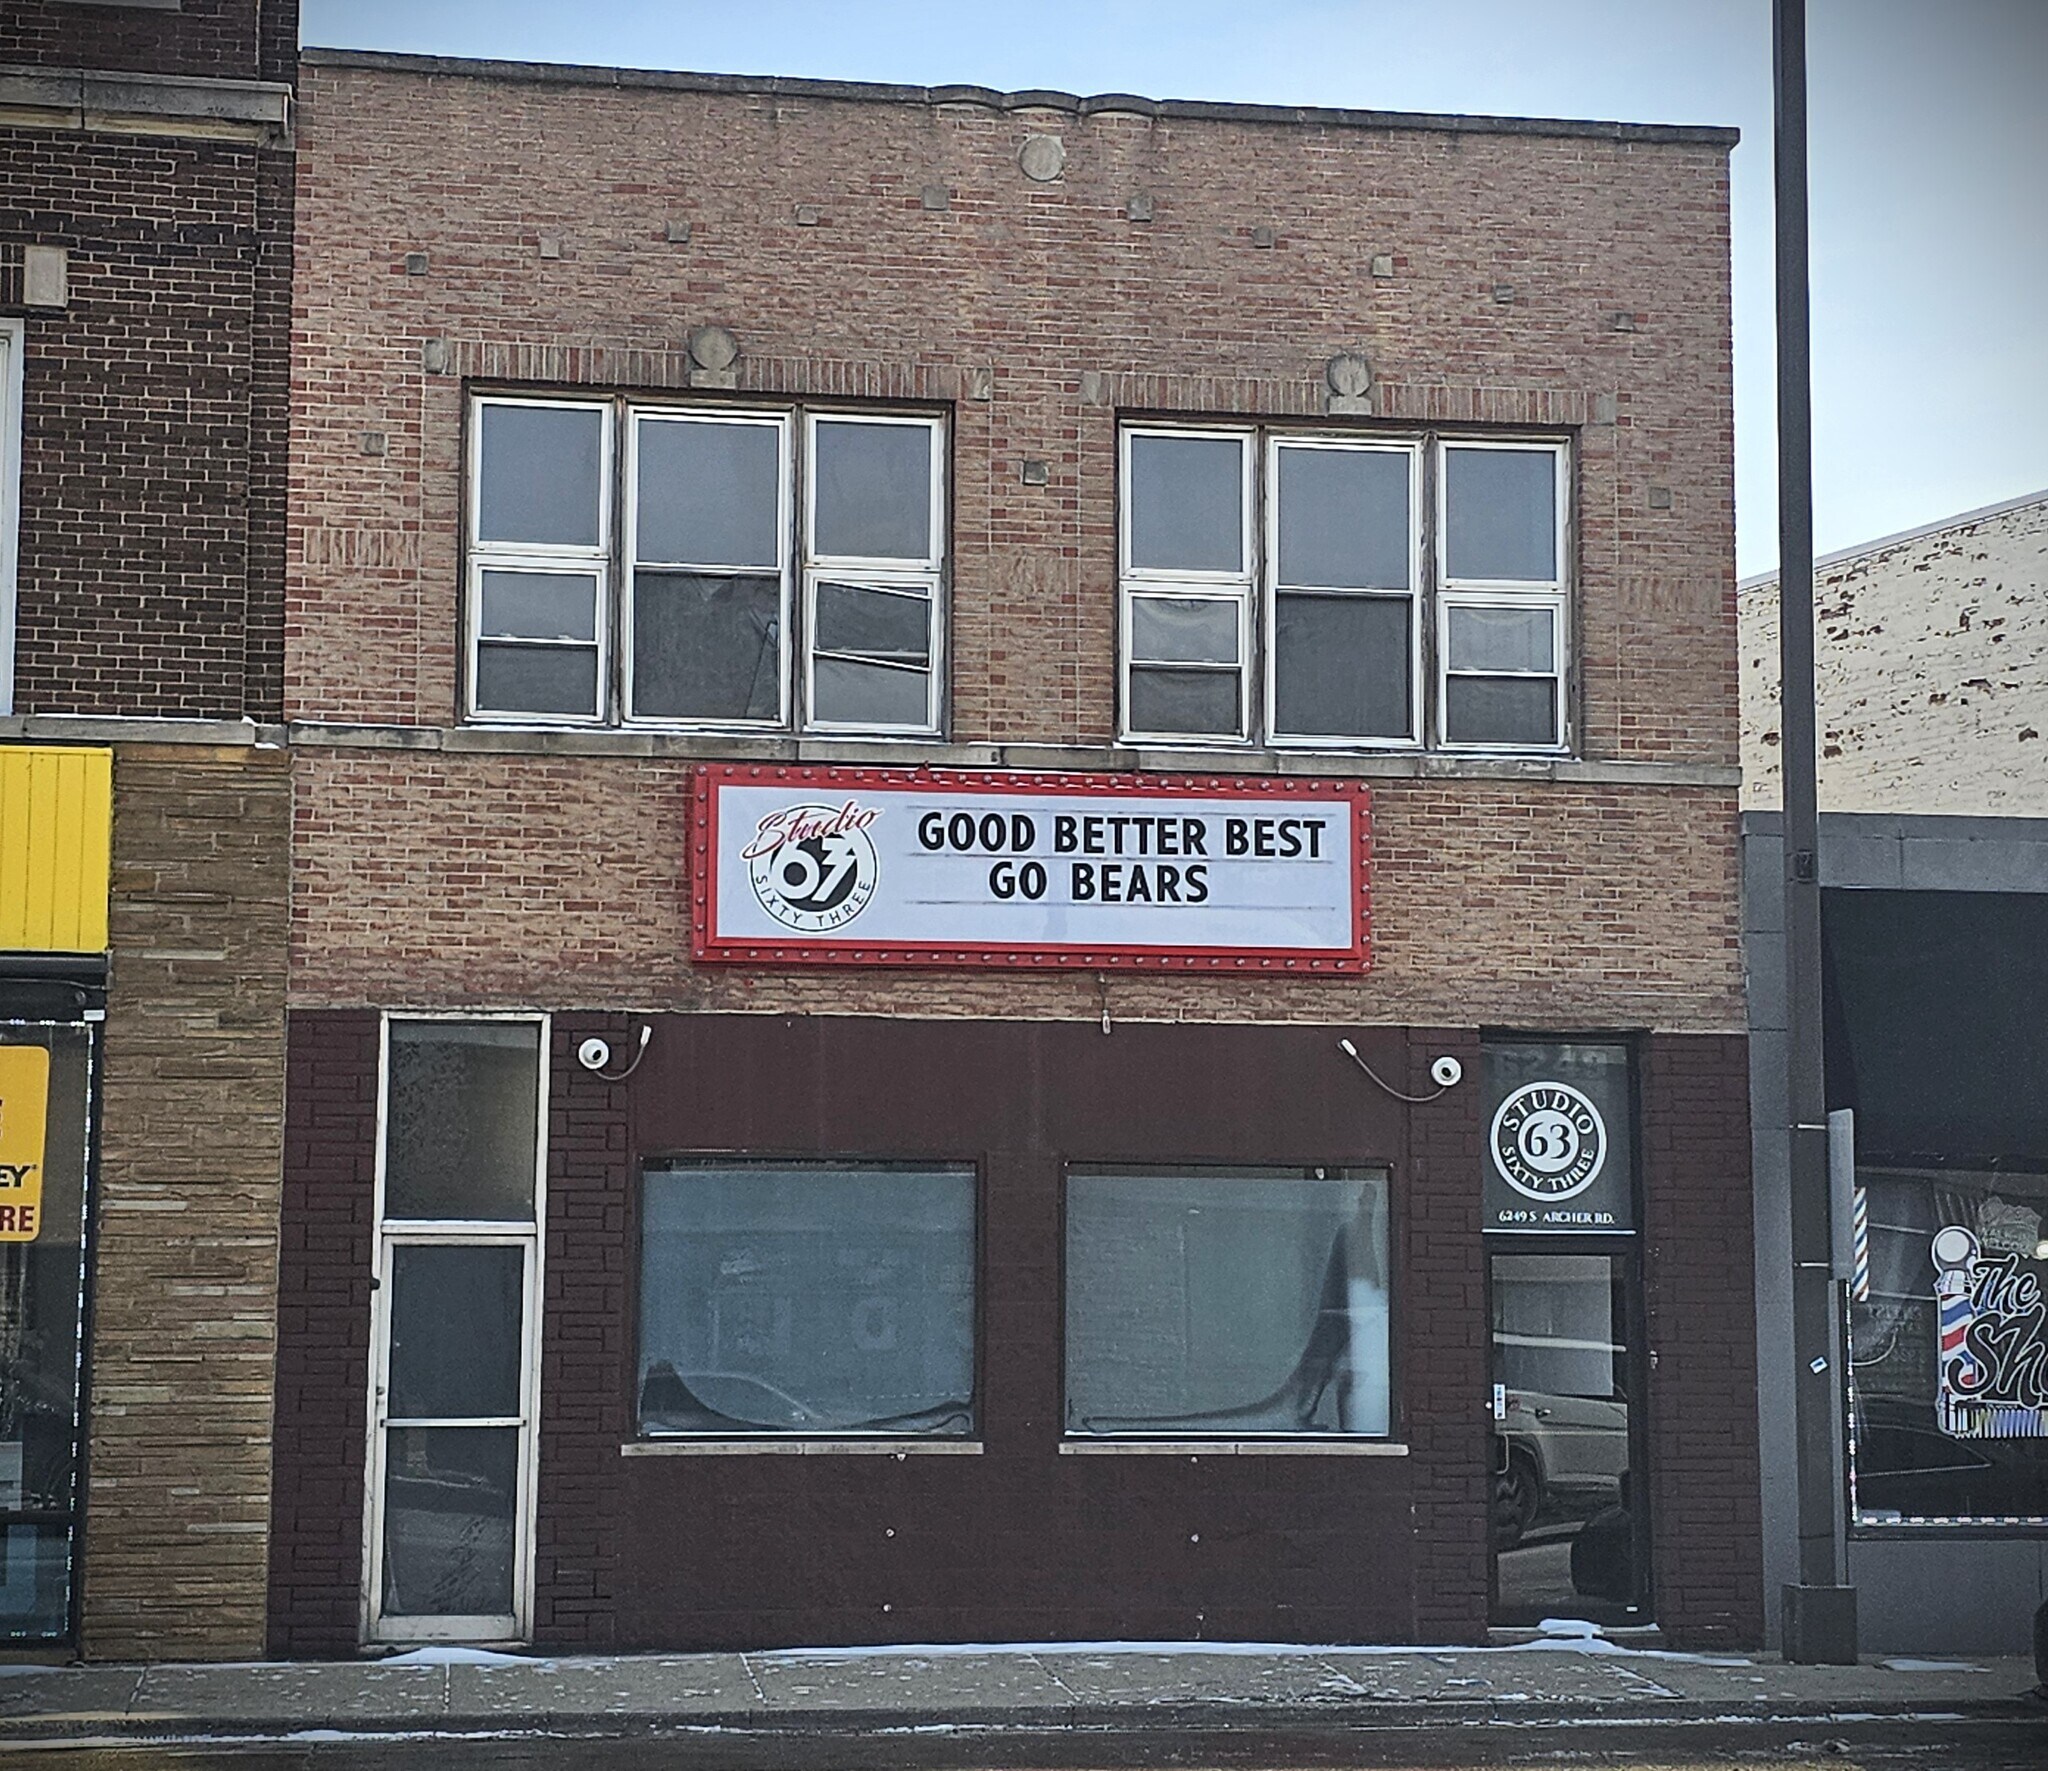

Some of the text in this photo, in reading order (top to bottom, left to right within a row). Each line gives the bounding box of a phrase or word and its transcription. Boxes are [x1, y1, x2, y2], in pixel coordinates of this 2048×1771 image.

[742, 800, 881, 859] Studio
[918, 811, 1327, 858] GOOD BETTER BEST
[756, 874, 871, 927] SIXTY THREE
[989, 861, 1209, 902] GO BEARS
[1502, 1090, 1594, 1135] STUDIO
[1524, 1121, 1571, 1160] 63
[1502, 1146, 1595, 1191] SIXTY THREE
[1543, 1211, 1592, 1223] ARCHER
[1972, 1253, 2041, 1316] The
[1946, 1303, 2048, 1410] Sh
